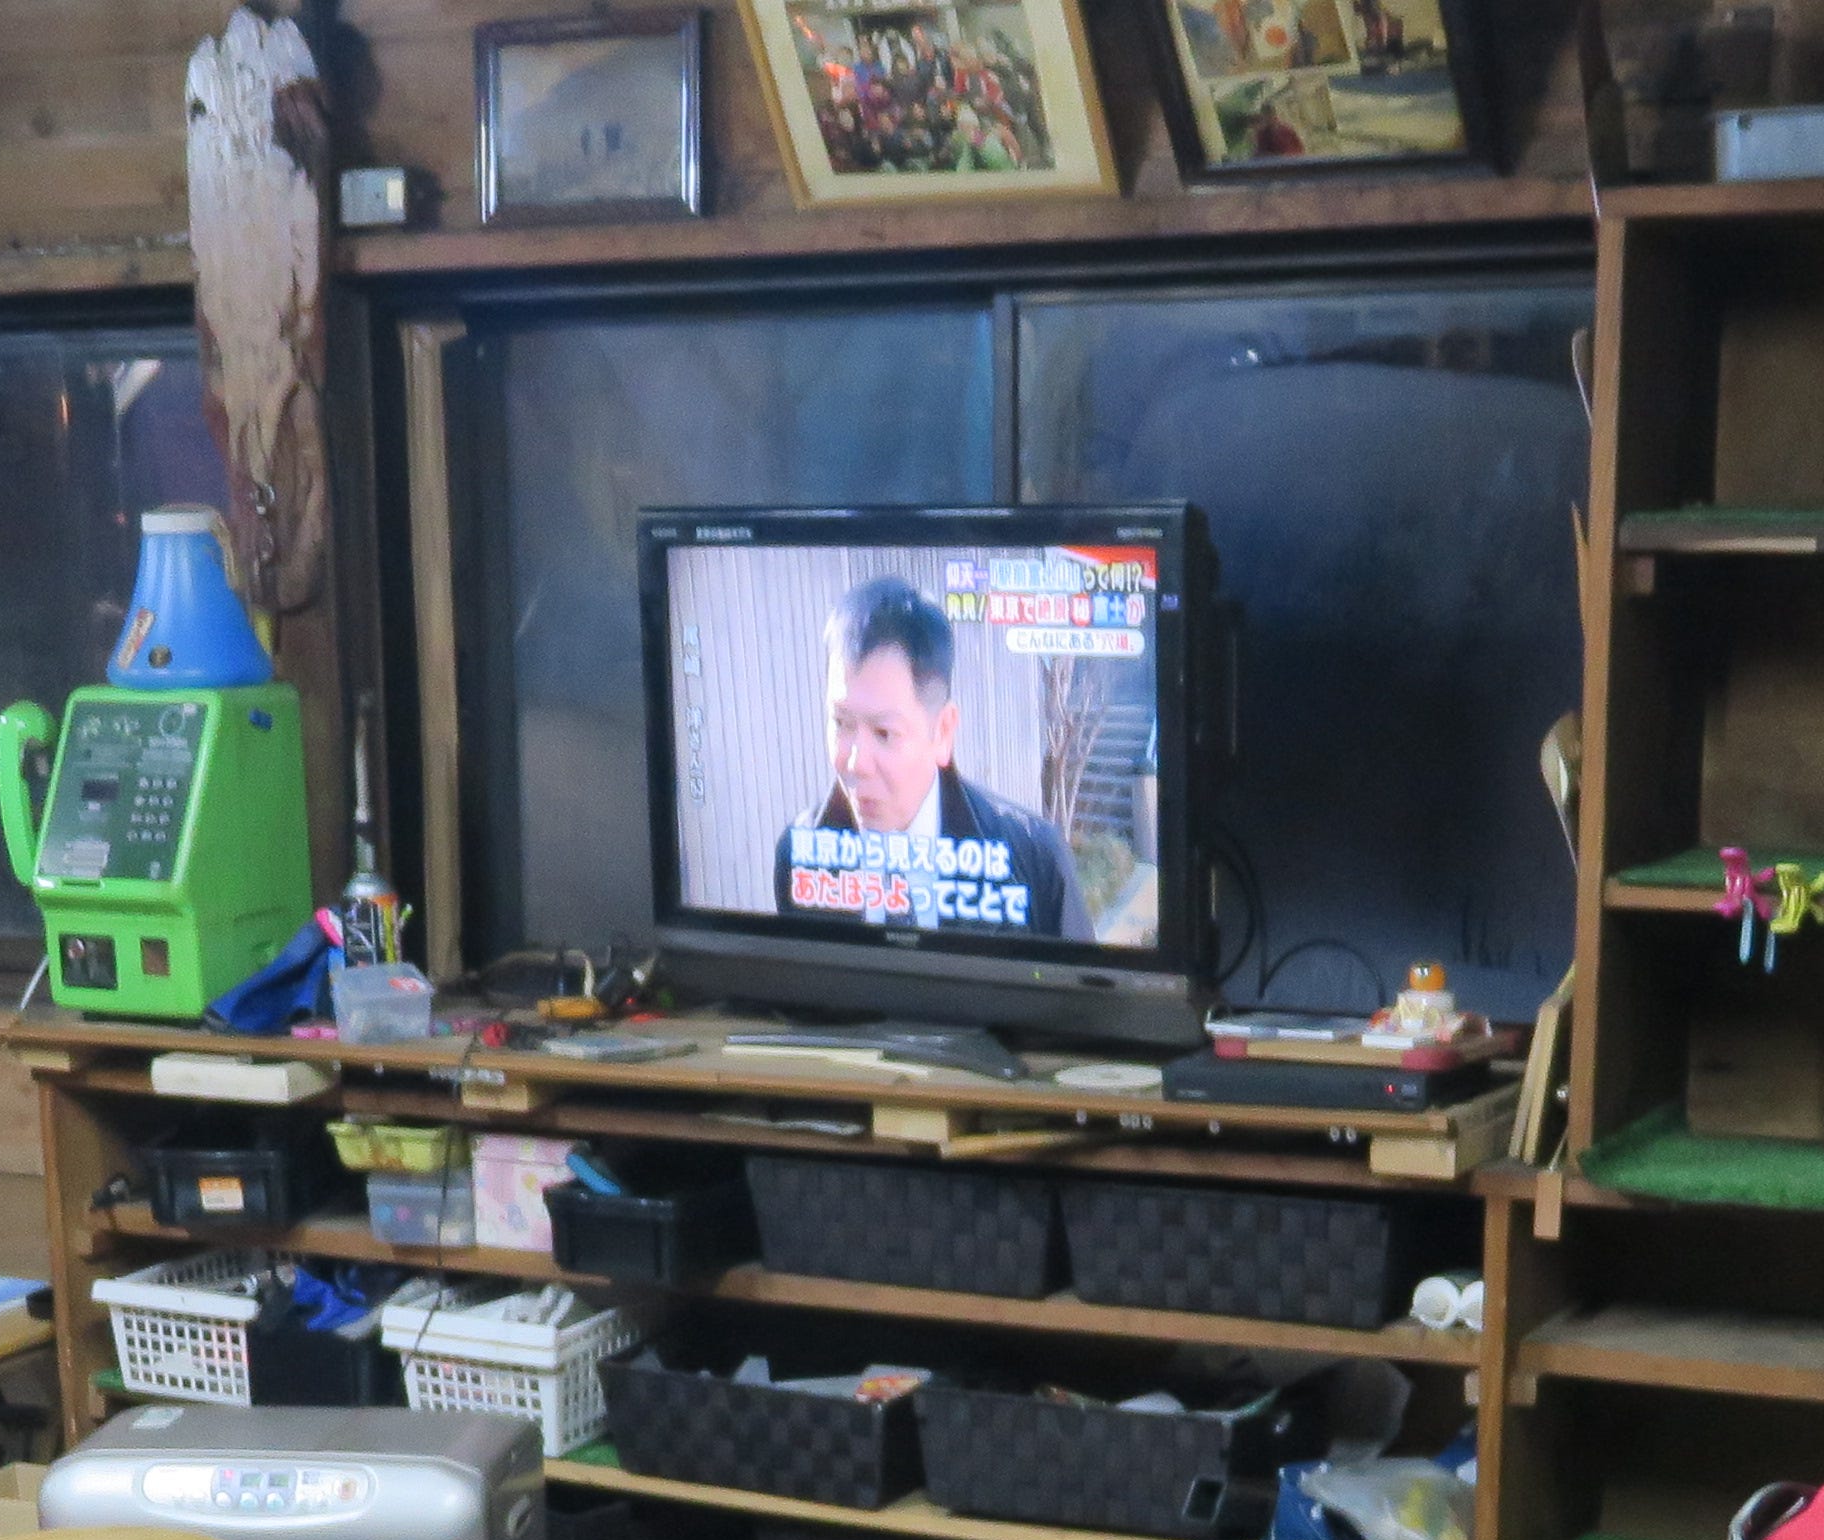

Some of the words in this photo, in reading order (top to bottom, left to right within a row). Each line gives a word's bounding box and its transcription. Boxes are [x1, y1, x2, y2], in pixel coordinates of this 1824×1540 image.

[791, 828, 1010, 880] 東京から見えるのは
[792, 867, 1029, 924] あたぼうよってことで
